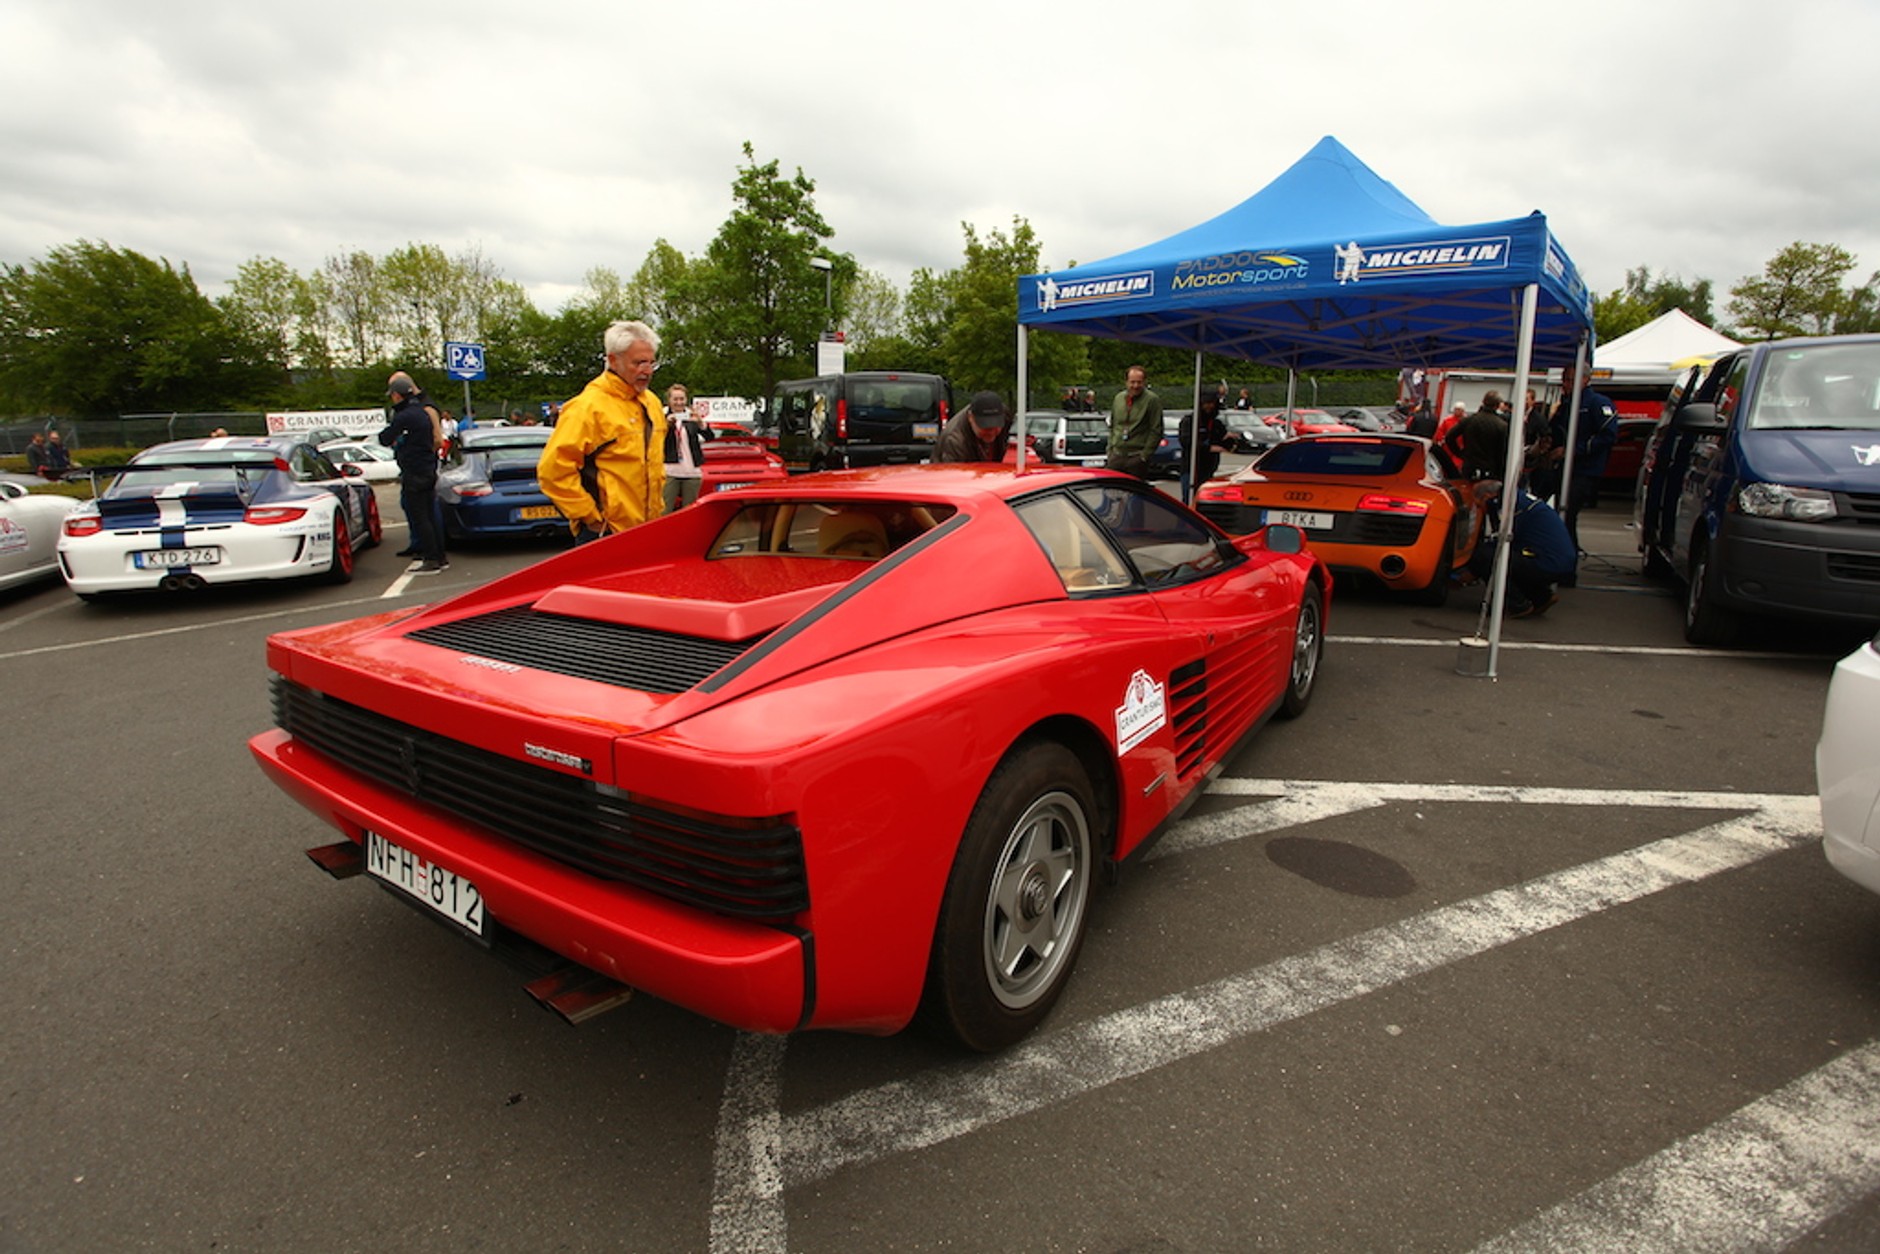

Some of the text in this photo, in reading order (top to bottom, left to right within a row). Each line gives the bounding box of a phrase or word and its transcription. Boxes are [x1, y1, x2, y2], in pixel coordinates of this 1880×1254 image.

[1366, 244, 1503, 268] MICHELIN
[1060, 276, 1149, 299] MICHELIN
[1171, 265, 1310, 290] Motorsport
[451, 347, 464, 367] P
[287, 413, 386, 427] GRANTURISMO
[147, 548, 213, 565] KTD 276
